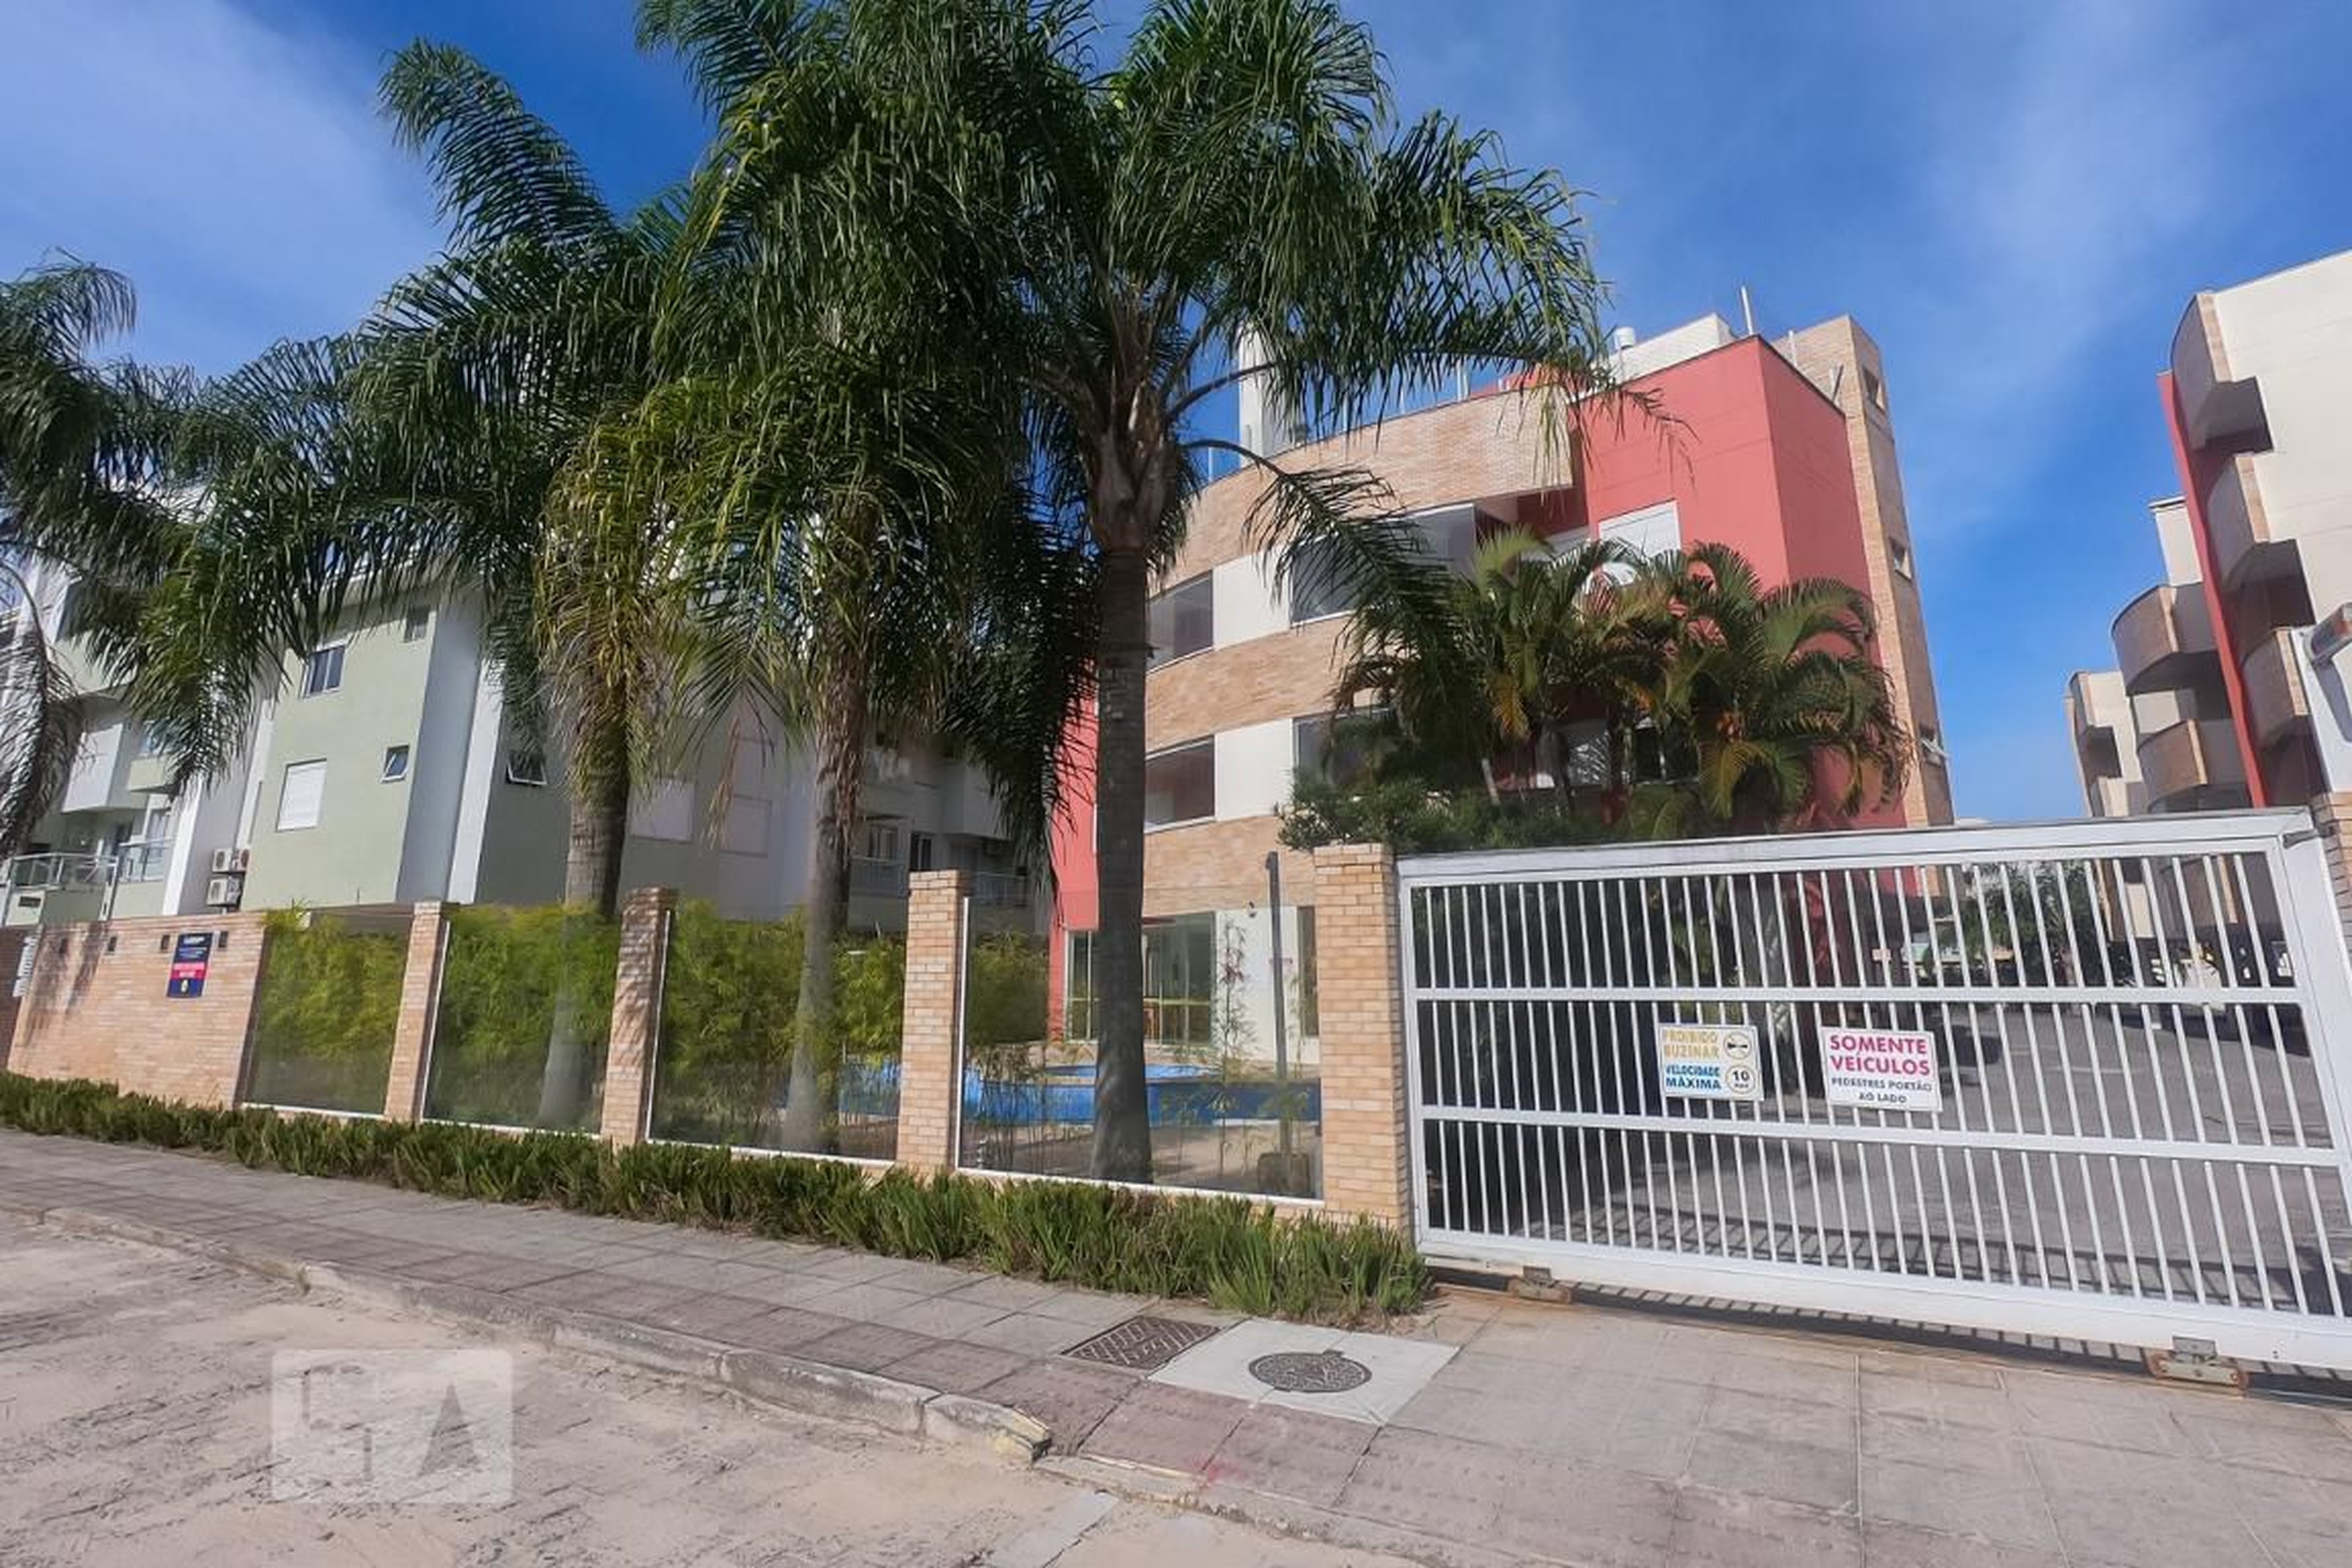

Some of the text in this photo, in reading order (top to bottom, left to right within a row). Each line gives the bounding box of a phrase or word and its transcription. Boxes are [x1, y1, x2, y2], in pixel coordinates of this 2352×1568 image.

[1830, 1035, 1928, 1054] SOMENTE
[1664, 1045, 1720, 1059] BUZINAR
[1665, 1065, 1721, 1077] VELOCIDADE
[1830, 1052, 1931, 1076] VEÍCULOS
[1665, 1076, 1722, 1090] MÁXIMA
[1732, 1070, 1750, 1082] 10
[1831, 1077, 1932, 1092] PEDESTRES PORTÃO
[1859, 1092, 1907, 1103] AO LADO
